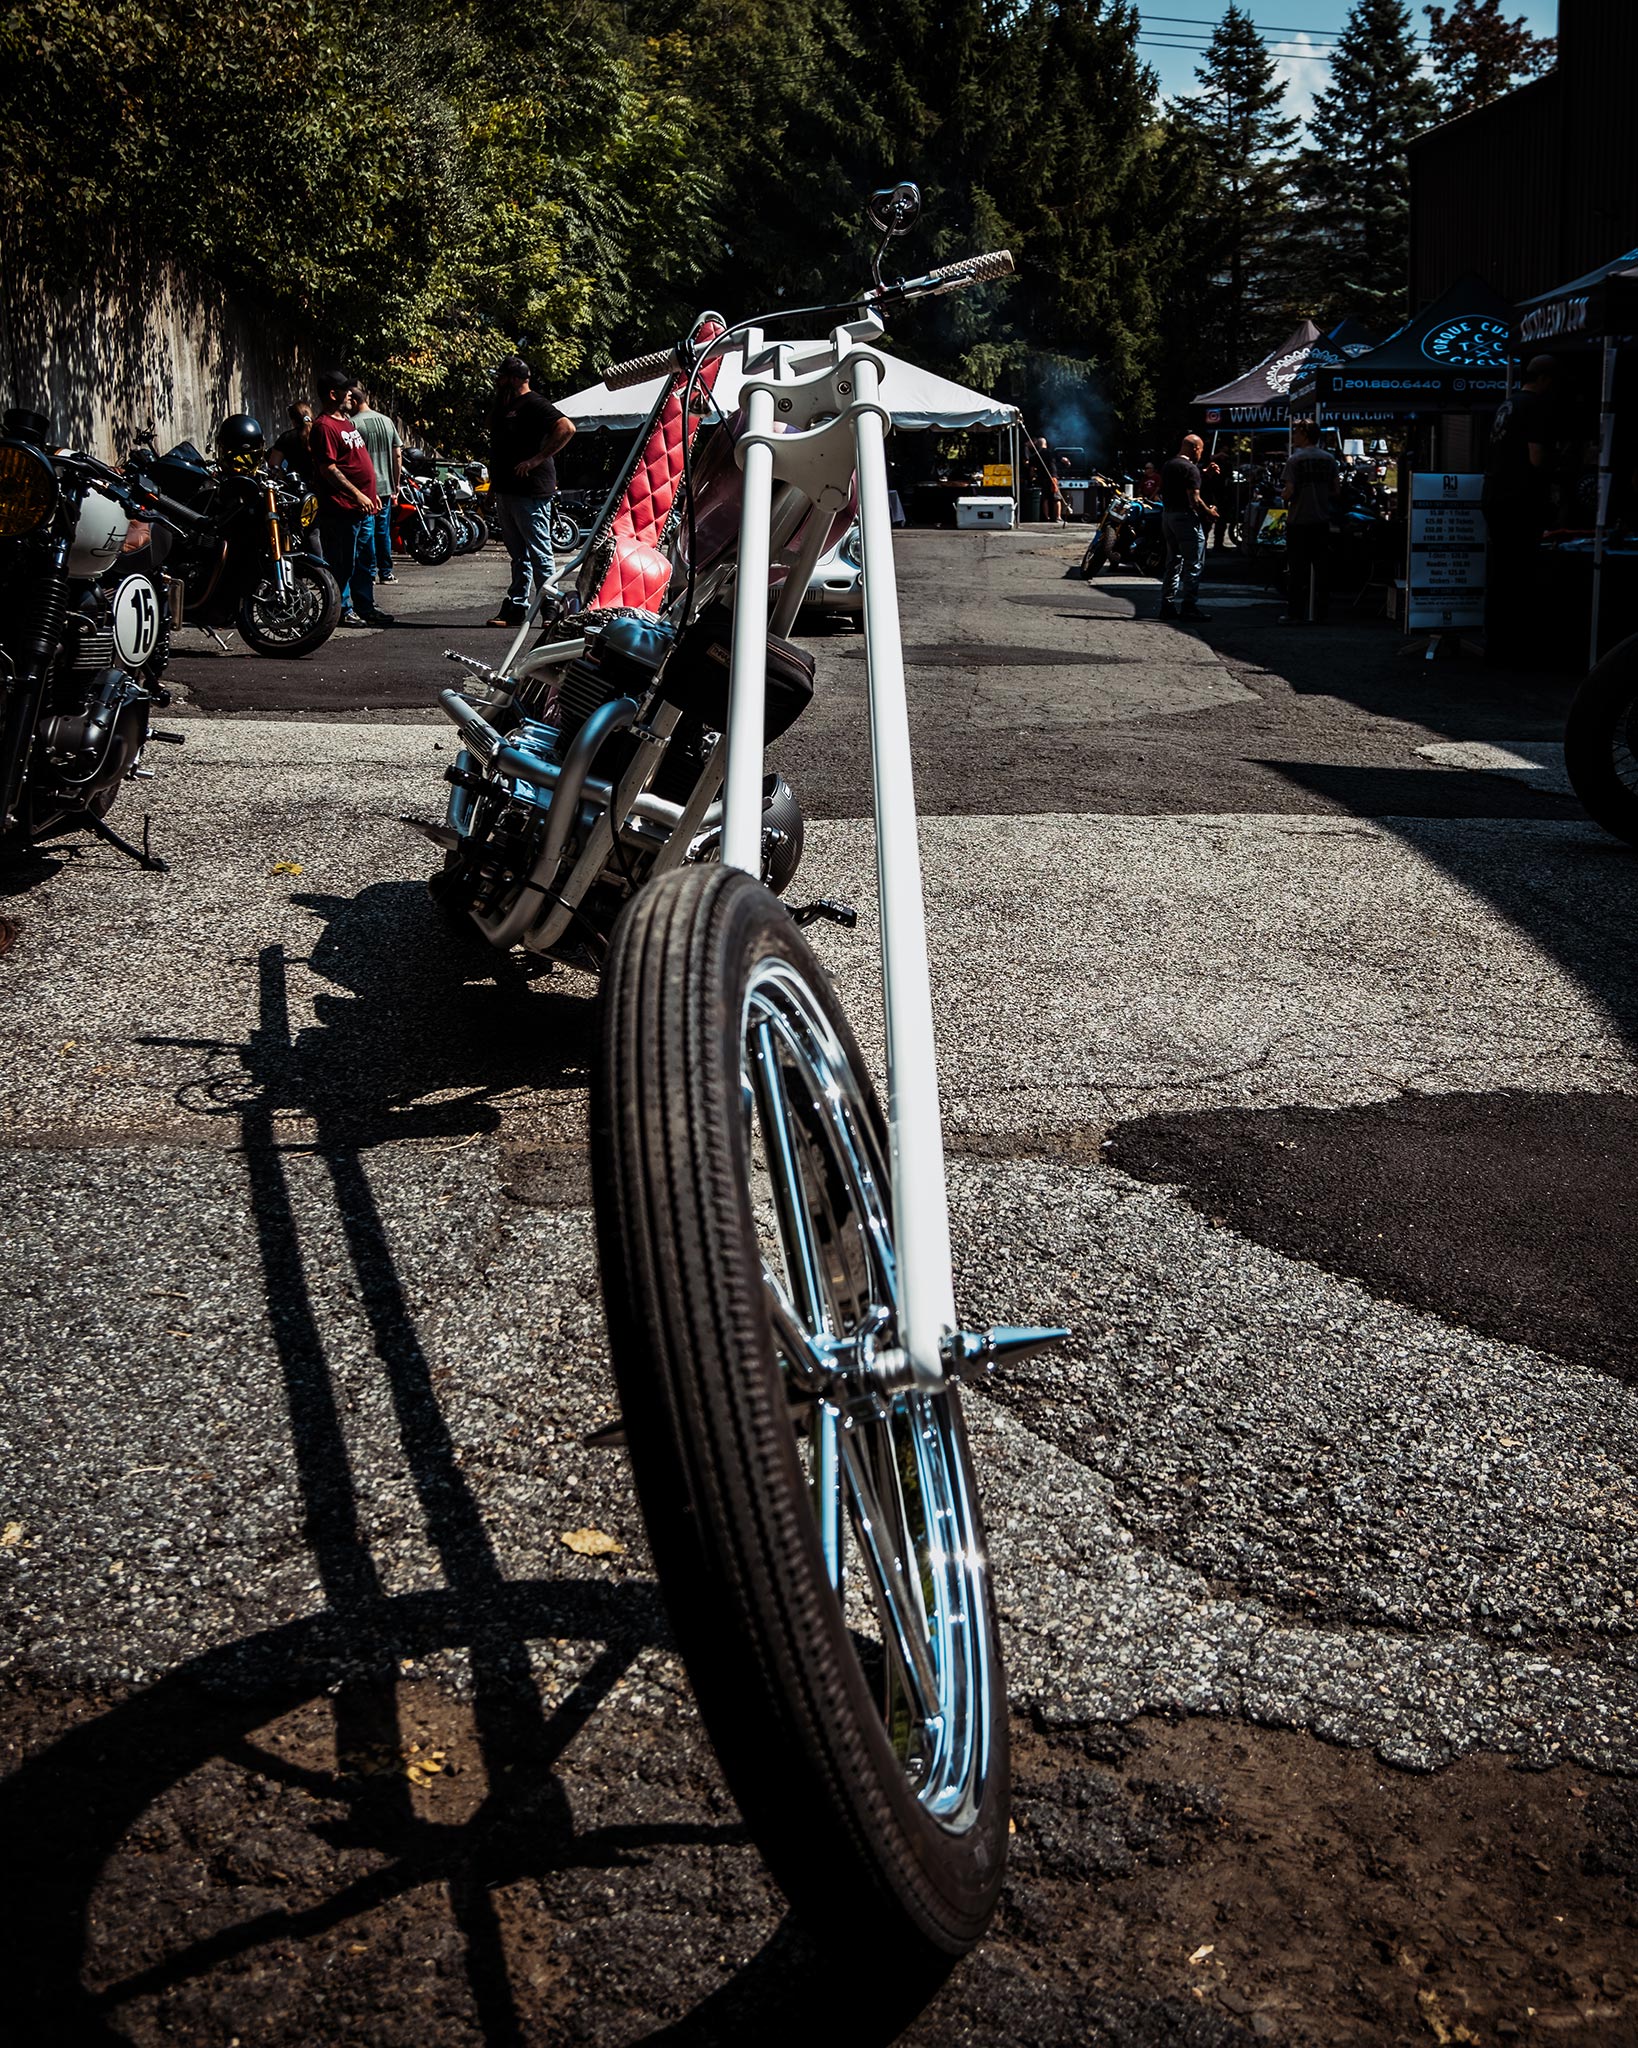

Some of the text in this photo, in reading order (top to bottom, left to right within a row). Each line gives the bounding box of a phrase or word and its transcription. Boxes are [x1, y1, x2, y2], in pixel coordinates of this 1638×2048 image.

[1433, 322, 1471, 355] TORQUE
[1344, 380, 1521, 390] 201.880.6440 TORQU
[131, 588, 155, 654] 15
